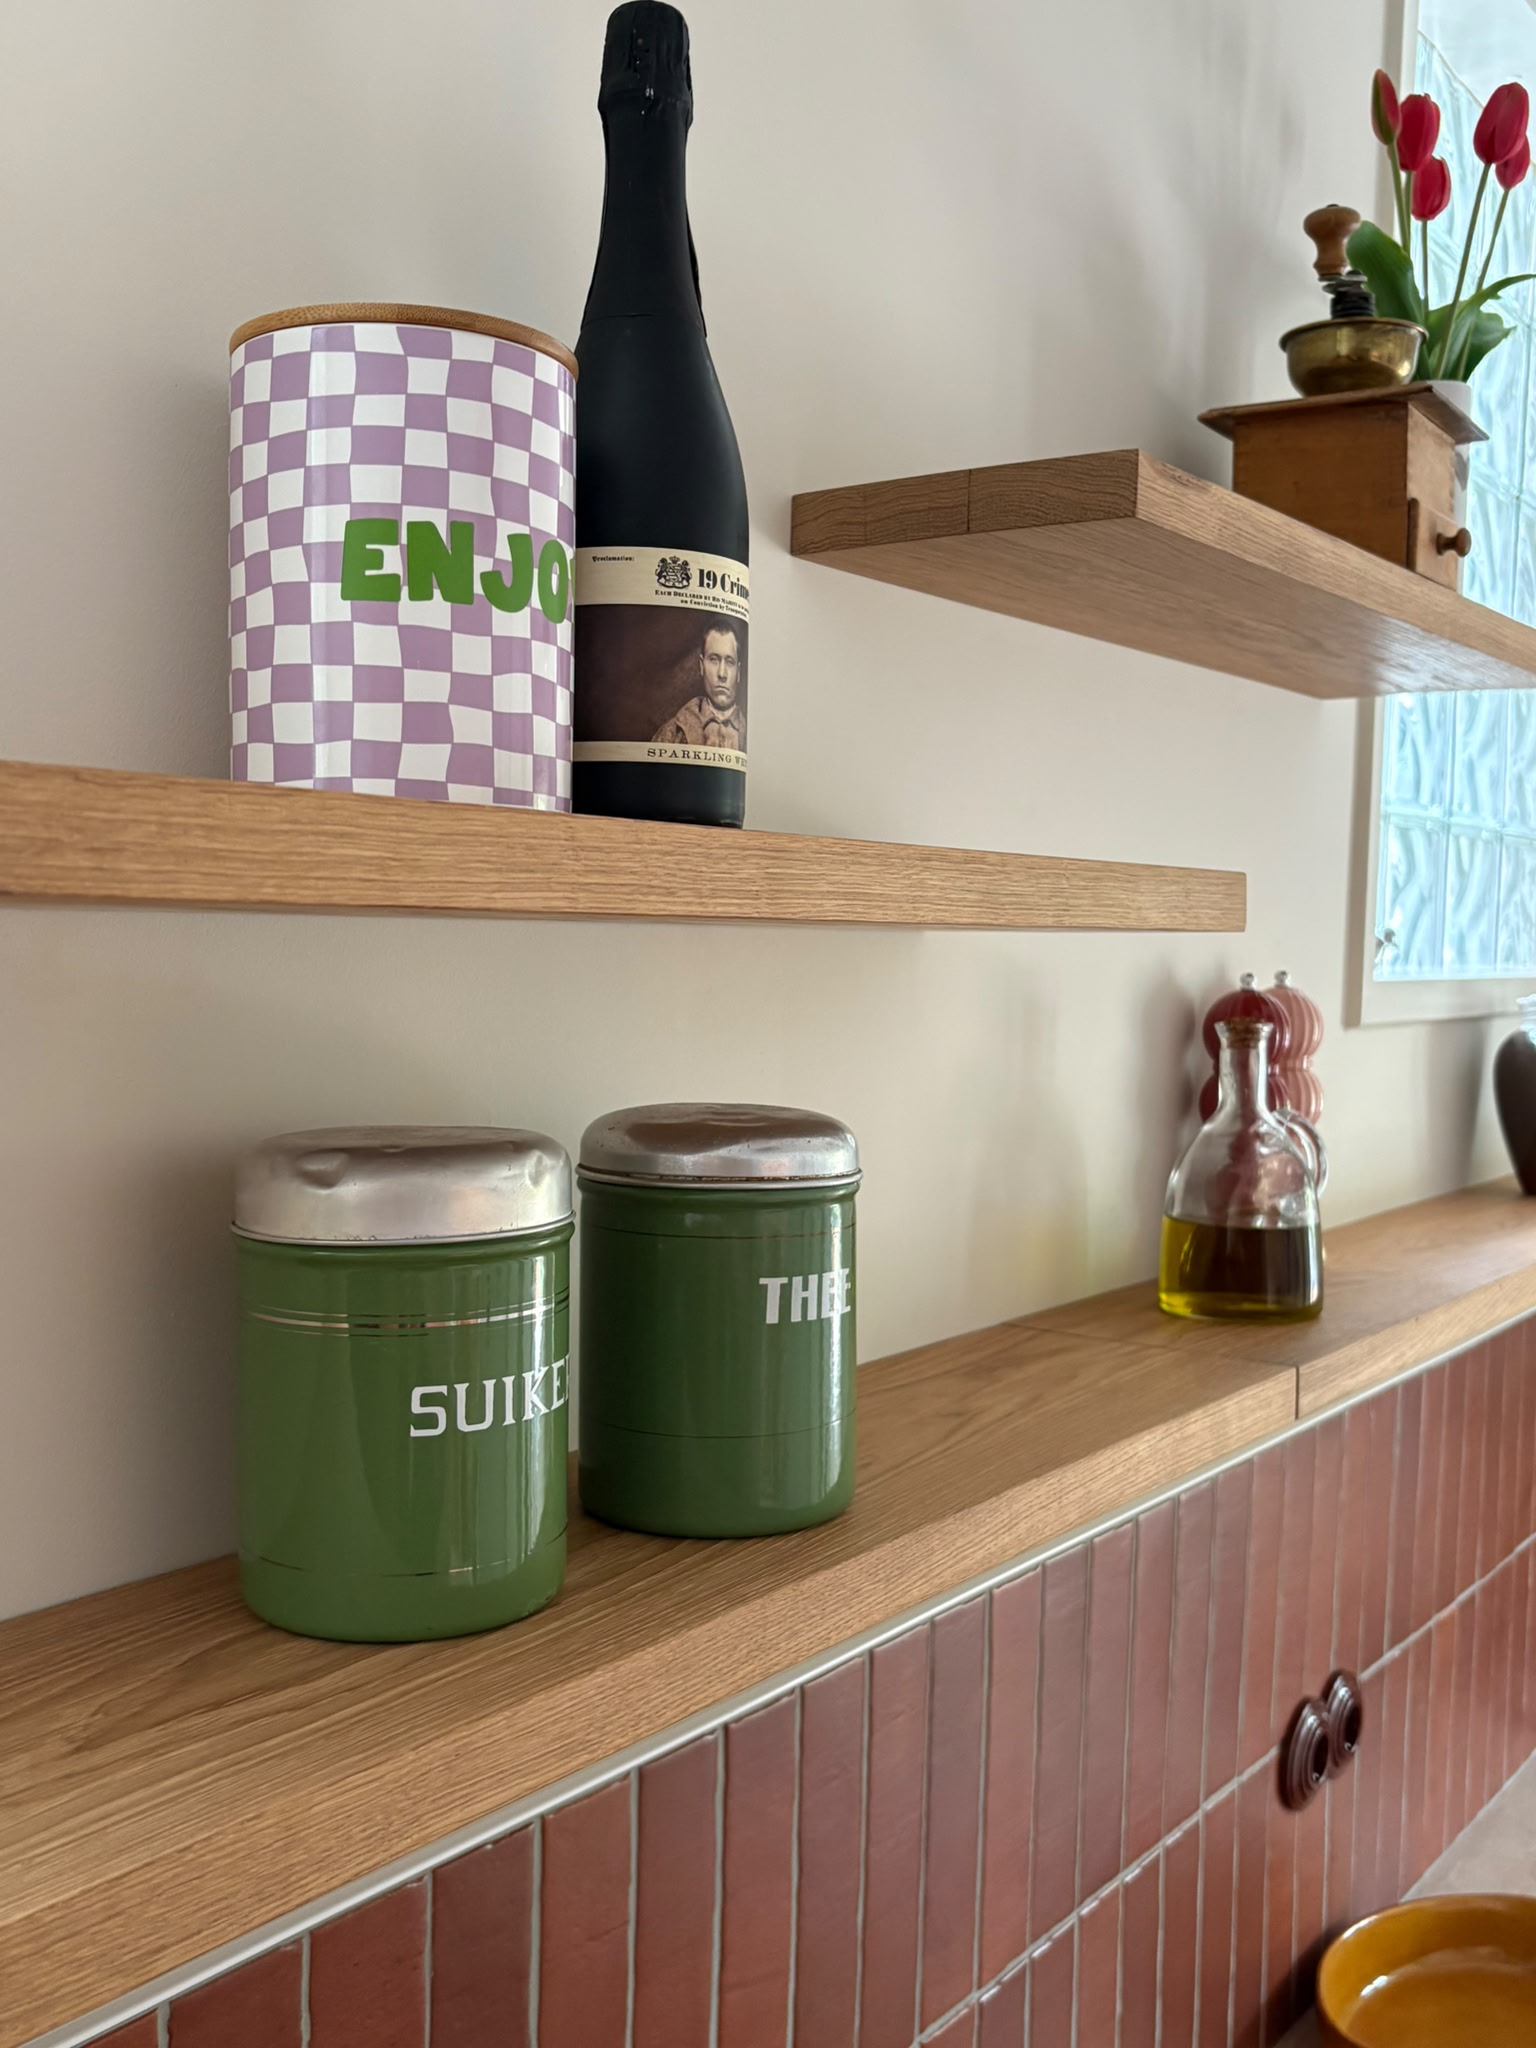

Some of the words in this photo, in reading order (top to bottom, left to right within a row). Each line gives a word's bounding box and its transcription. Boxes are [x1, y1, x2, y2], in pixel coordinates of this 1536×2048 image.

[341, 518, 576, 624] ENJO
[697, 568, 718, 590] 19
[647, 748, 732, 764] SPARKLING
[759, 1267, 851, 1324] THEE
